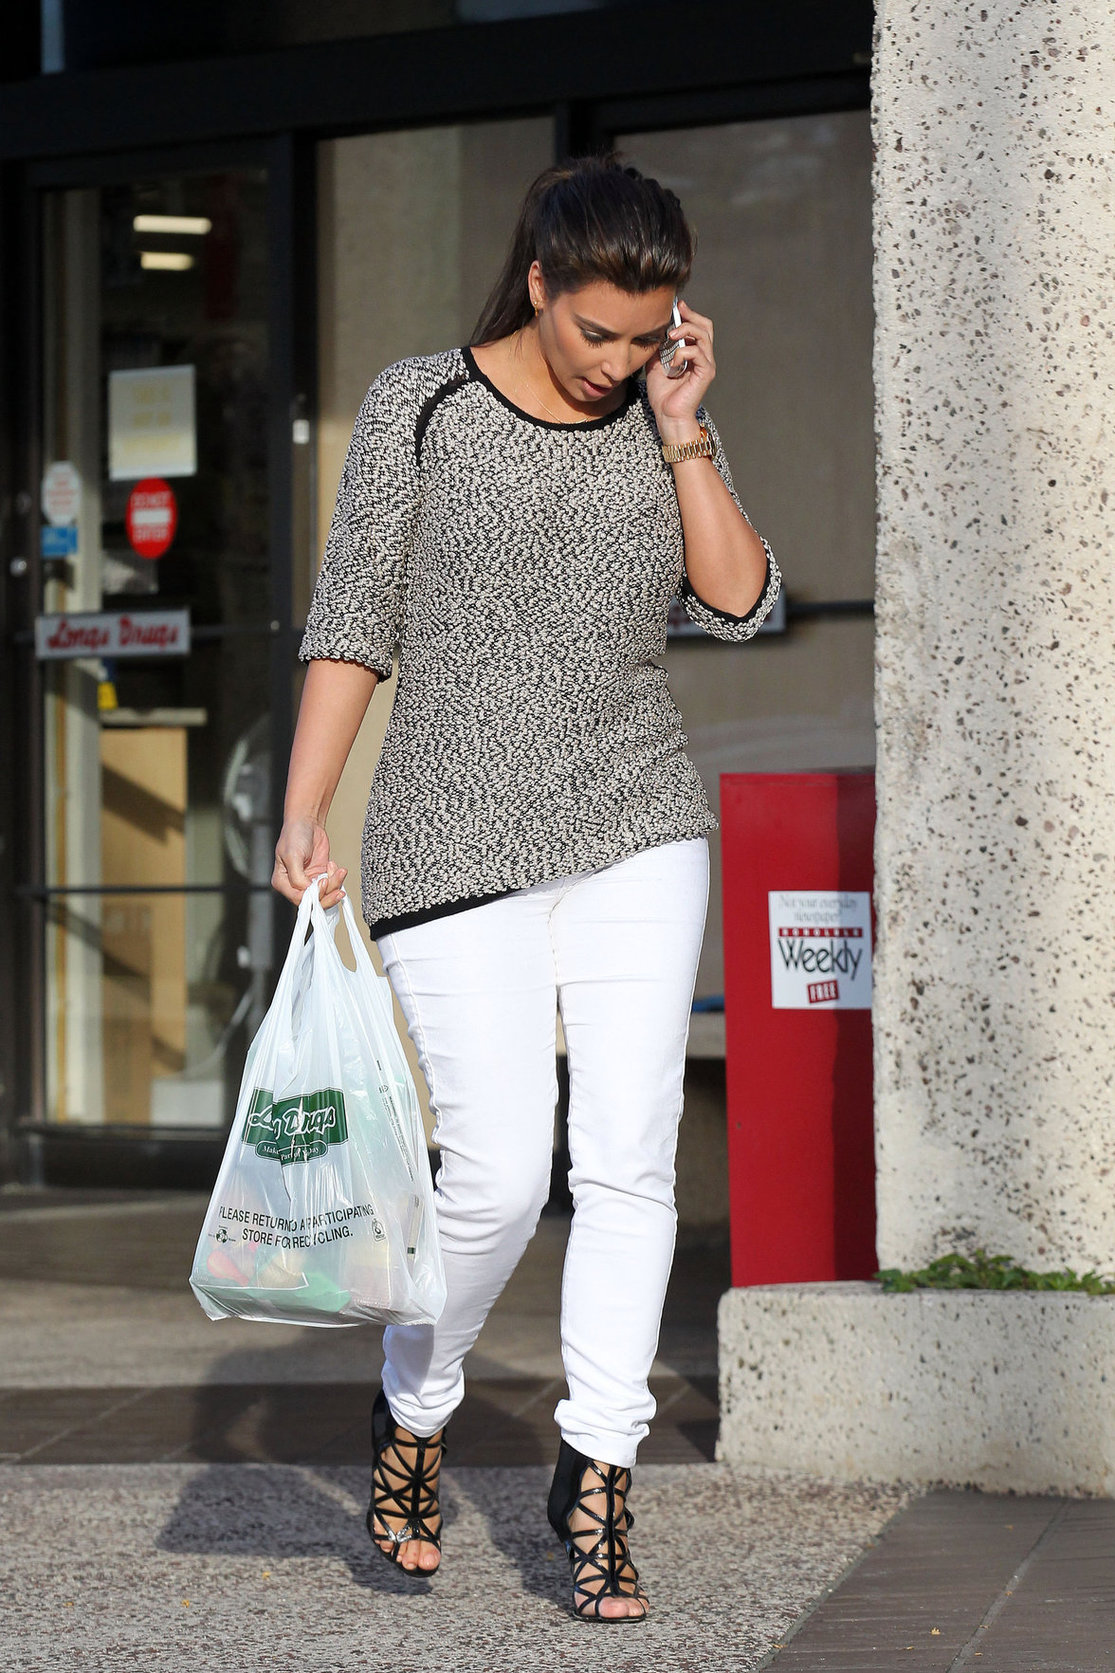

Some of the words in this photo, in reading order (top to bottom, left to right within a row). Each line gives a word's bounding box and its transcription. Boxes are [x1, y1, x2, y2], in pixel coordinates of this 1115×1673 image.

[47, 617, 110, 651] Longs
[119, 613, 178, 650] Drugs
[778, 939, 863, 980] Weekly
[809, 982, 837, 1002] FREE
[252, 1213, 290, 1232] RETURN
[242, 1228, 273, 1246] STORE
[275, 1235, 291, 1249] FOR
